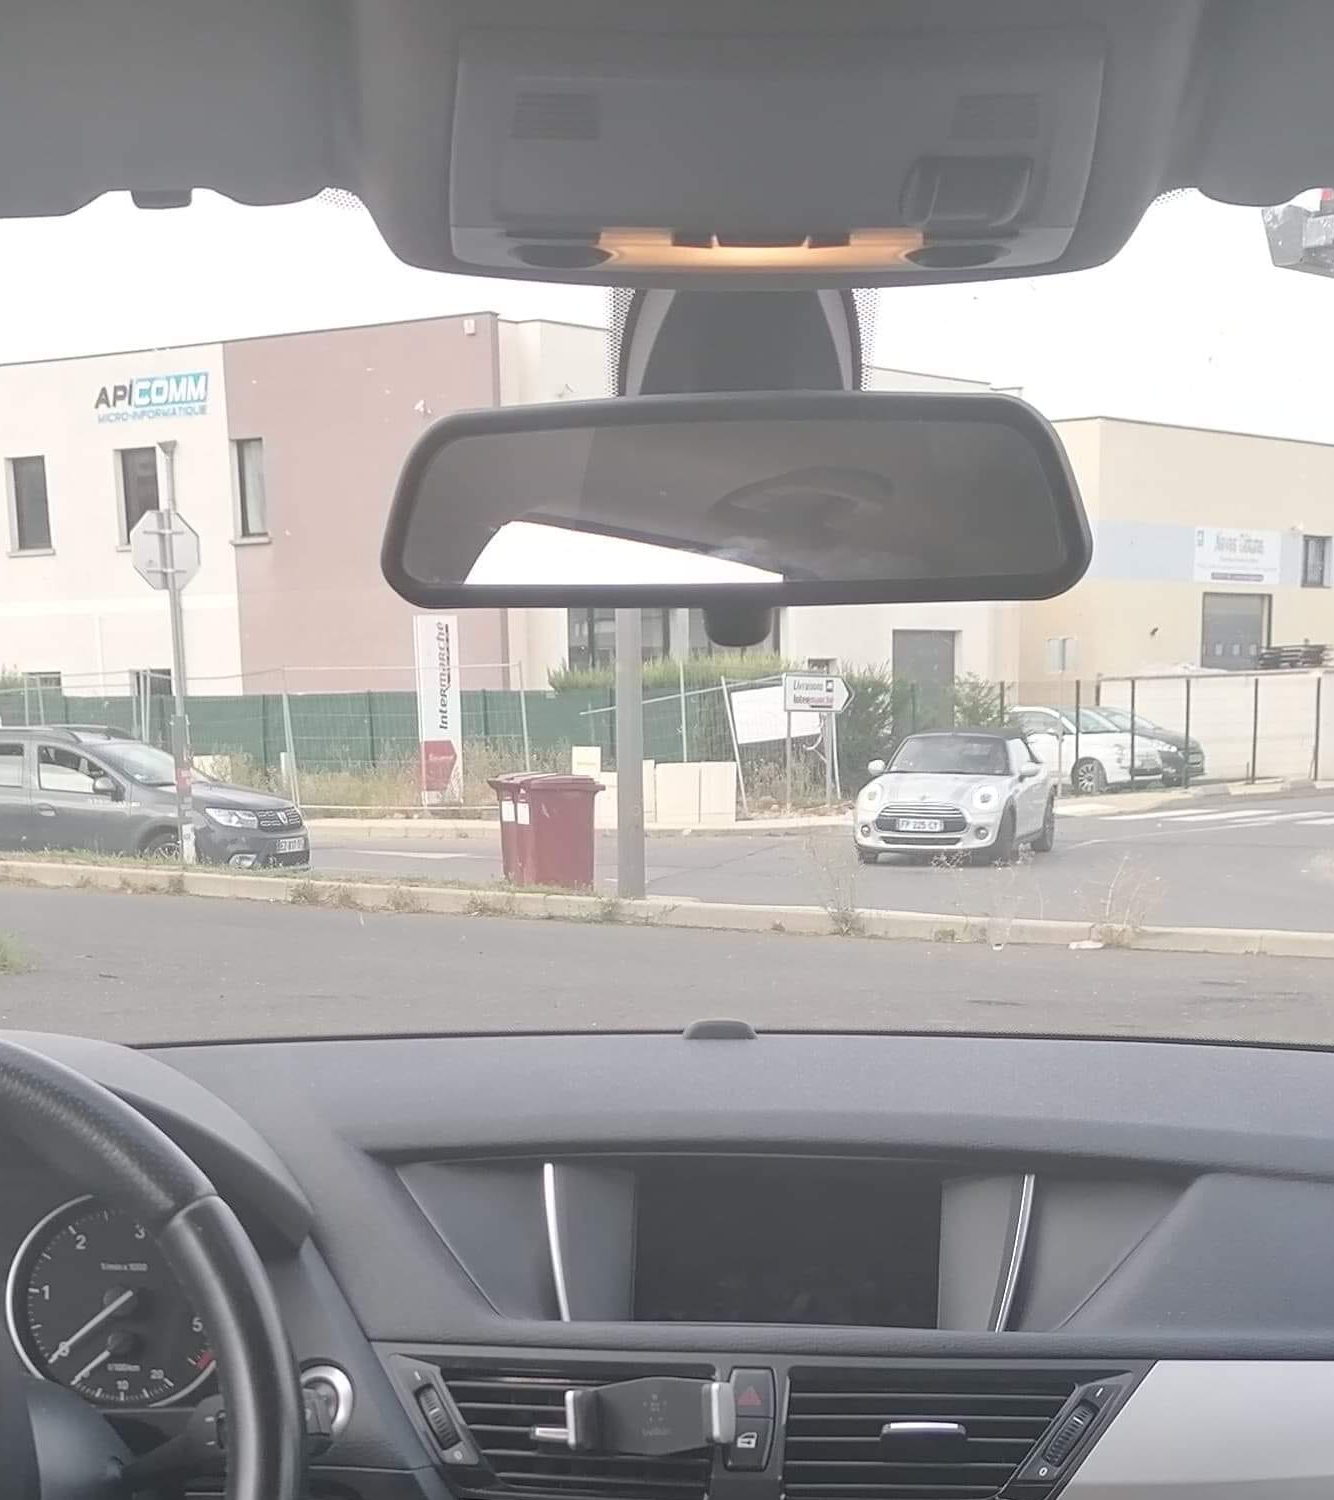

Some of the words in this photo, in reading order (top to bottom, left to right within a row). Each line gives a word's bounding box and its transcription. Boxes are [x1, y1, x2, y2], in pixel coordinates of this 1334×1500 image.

[94, 372, 208, 409] APICOMM
[97, 405, 208, 423] MICRO-INFORMATIQUE
[793, 679, 824, 691] Livraisons
[135, 1224, 146, 1239] 3
[74, 1235, 87, 1250] 2
[42, 1285, 51, 1300] 1
[191, 1317, 203, 1333] 5
[150, 1369, 164, 1380] 20
[116, 1379, 129, 1390] 10
